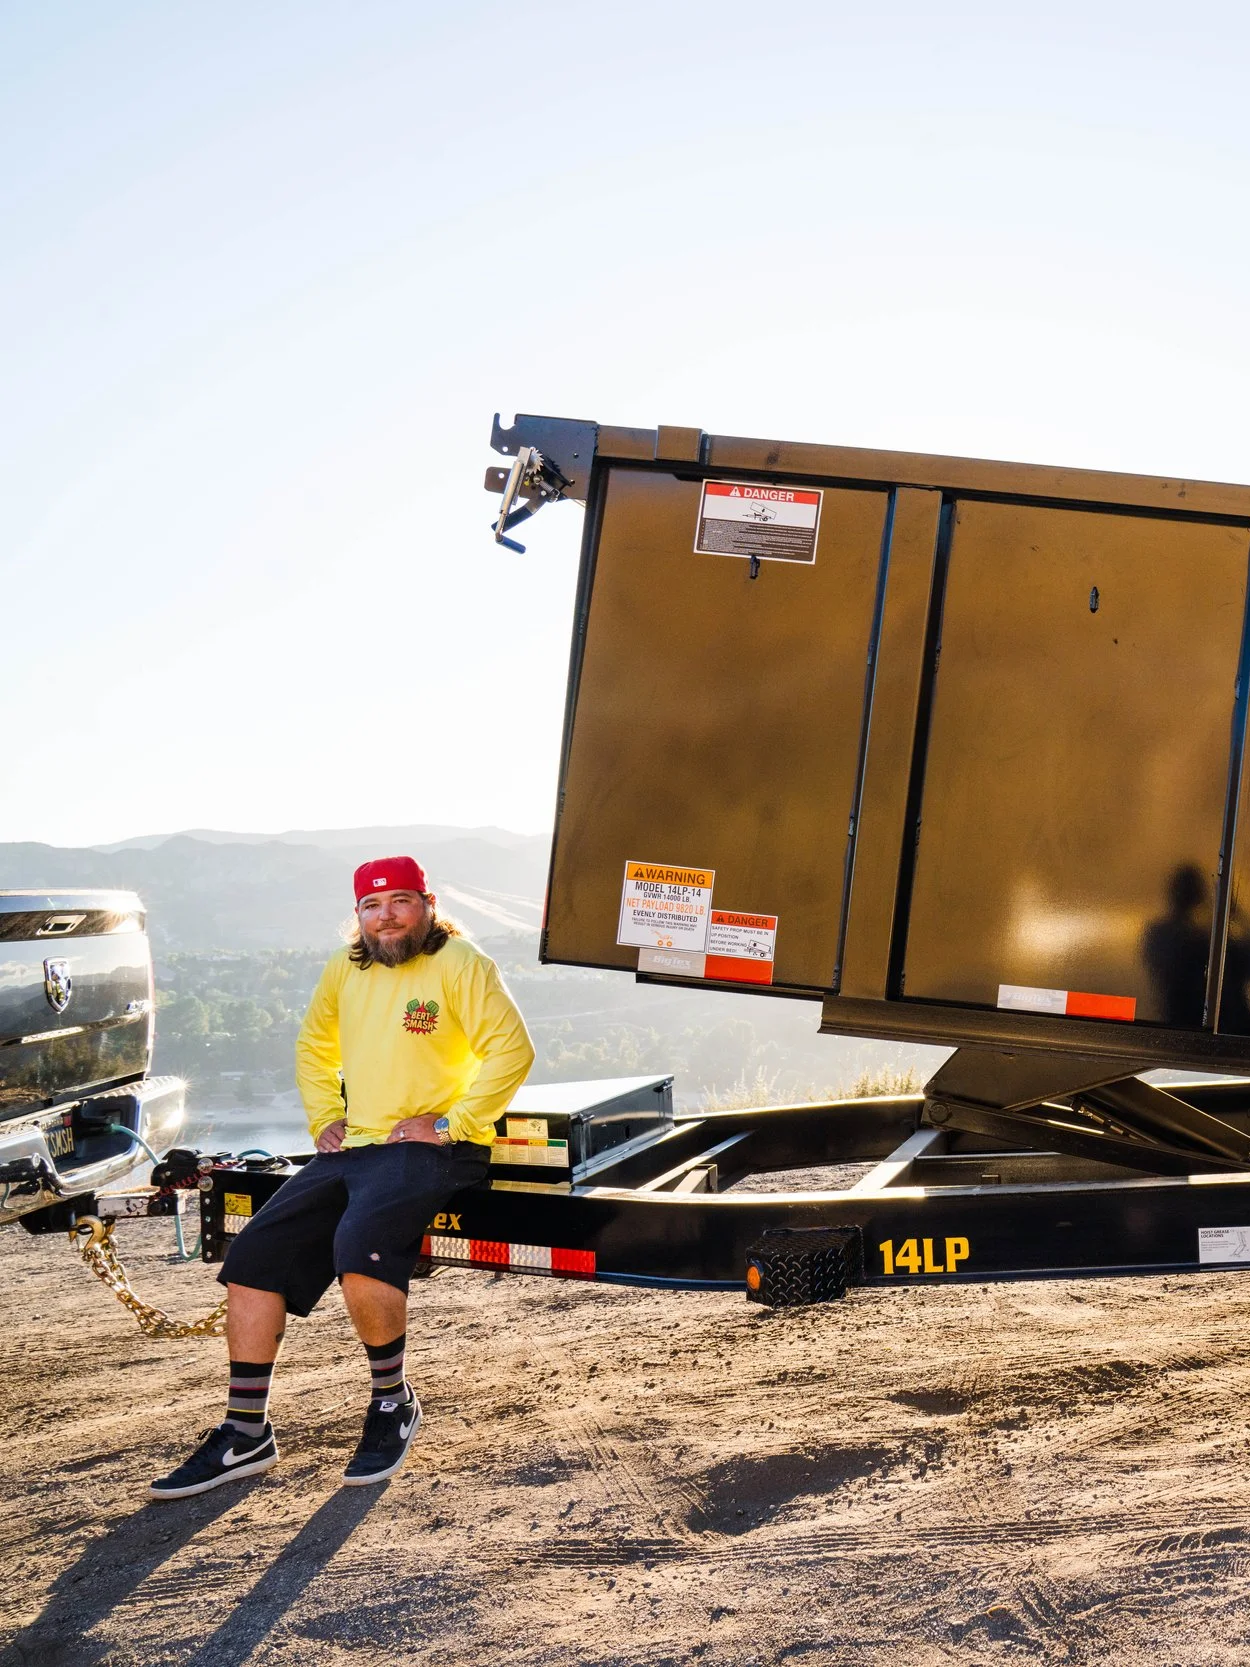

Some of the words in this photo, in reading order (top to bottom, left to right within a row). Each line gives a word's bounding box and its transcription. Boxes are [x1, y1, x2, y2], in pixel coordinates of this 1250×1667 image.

[743, 487, 795, 502] DANGER
[645, 868, 706, 885] WARNING
[635, 881, 665, 893] MODEL
[667, 885, 702, 897] 14LP-14
[643, 891, 662, 900] GVWR
[663, 893, 681, 902] 14000
[626, 897, 641, 908] NET
[641, 899, 674, 912] PAYLOAD
[633, 909, 656, 919] EVENLY
[657, 911, 698, 923] DISTRIBUTED
[727, 915, 768, 927] DANGER
[411, 1011, 430, 1021] BERT
[404, 1018, 434, 1031] SMASH
[427, 1213, 462, 1230] ex
[879, 1236, 970, 1275] 14LP
